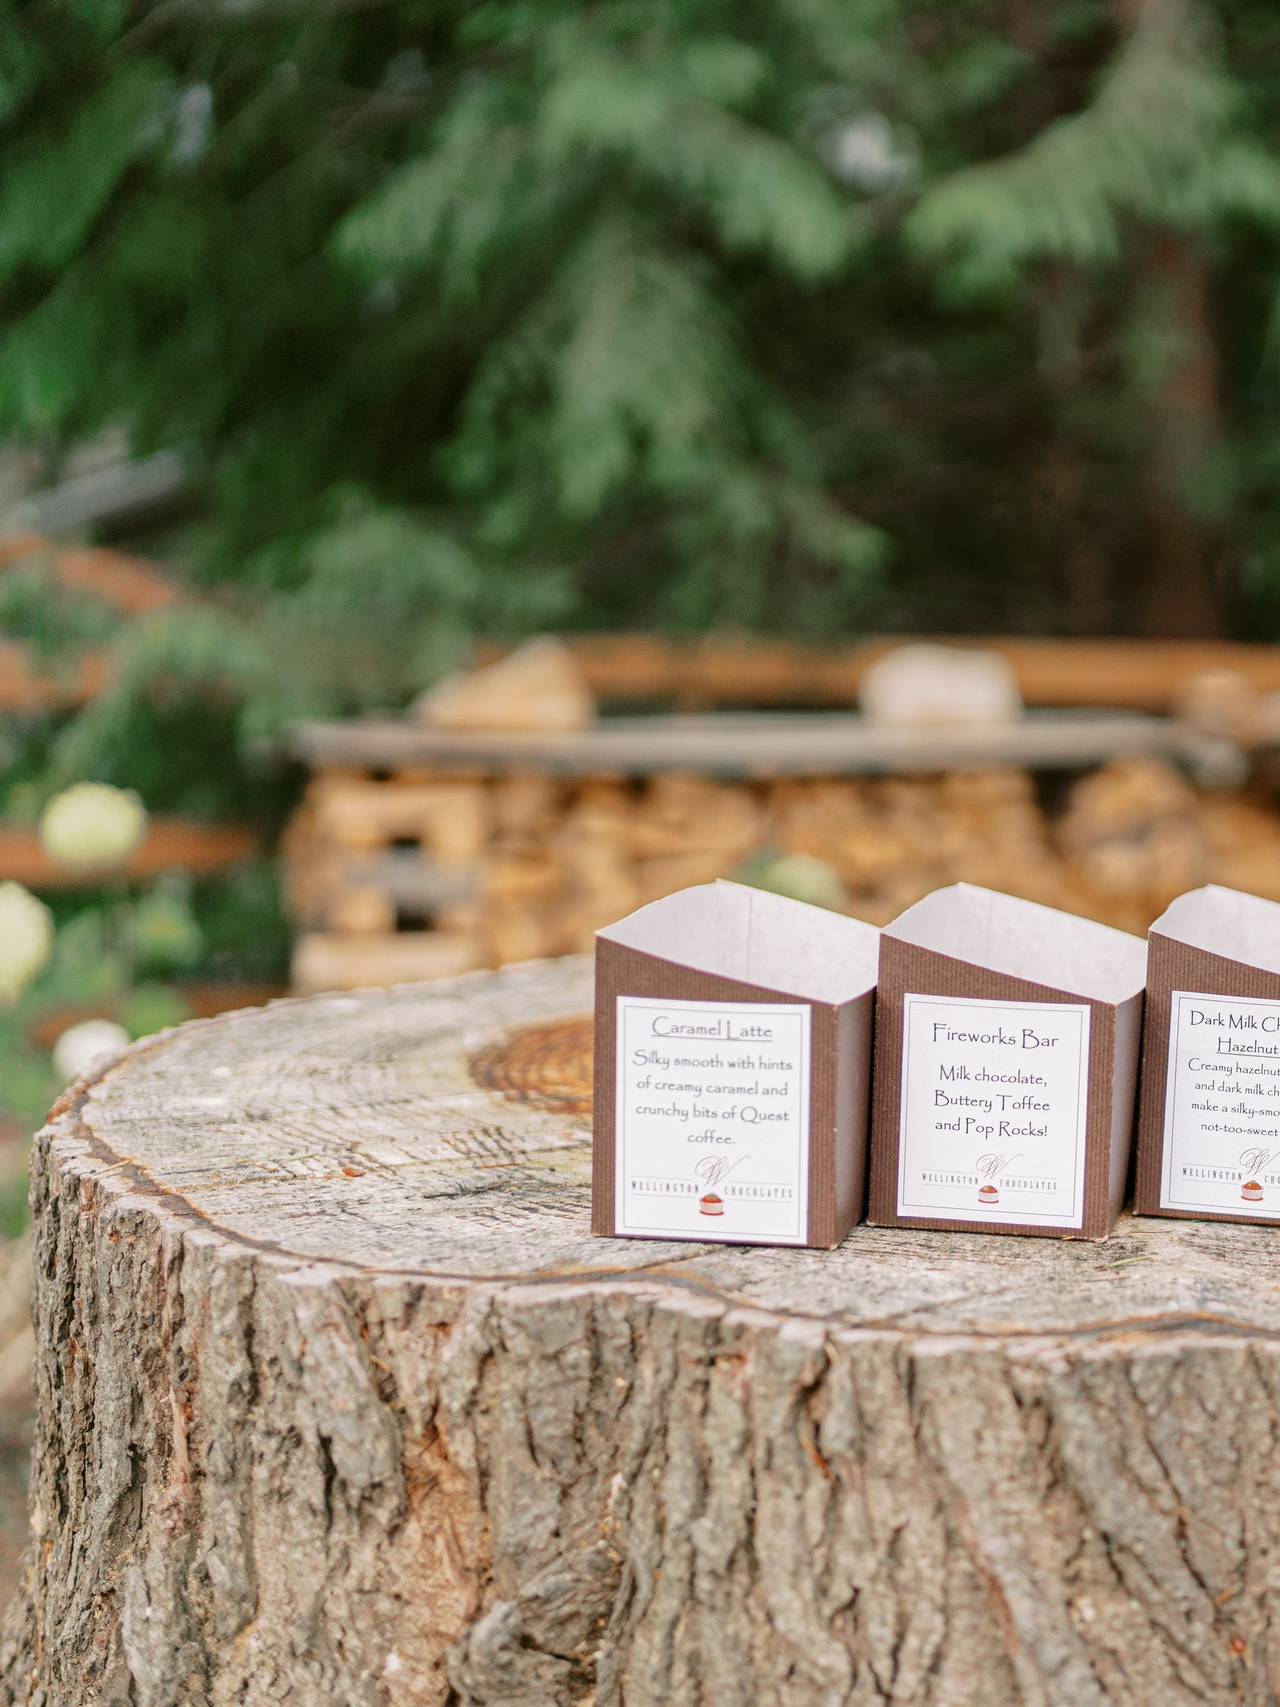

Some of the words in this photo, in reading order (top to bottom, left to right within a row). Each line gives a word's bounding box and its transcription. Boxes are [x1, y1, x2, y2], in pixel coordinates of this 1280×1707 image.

[652, 1015, 721, 1036] Caramel
[726, 1020, 773, 1039] Latte
[1190, 1010, 1225, 1026] Dark
[1229, 1014, 1258, 1029] Milk
[933, 1023, 1016, 1045] Fireworks
[1021, 1029, 1059, 1049] Bar
[1217, 1037, 1279, 1054] Hazelnut
[632, 1049, 670, 1070] Silky
[673, 1054, 723, 1068] smooth
[727, 1056, 755, 1069] with
[759, 1056, 792, 1070] hints
[1188, 1058, 1232, 1076] Creamy
[1236, 1062, 1280, 1076] hazelnut
[939, 1065, 971, 1081] Milk
[974, 1067, 1048, 1087] chocolate,
[637, 1075, 652, 1090] of
[654, 1081, 702, 1097] creamy
[706, 1081, 758, 1095] caramel
[762, 1082, 788, 1096] and
[1195, 1080, 1214, 1091] and
[1218, 1081, 1242, 1094] dark
[1245, 1084, 1264, 1096] milk
[934, 1090, 992, 1113] Buttery
[996, 1094, 1050, 1111] Toffee
[1191, 1100, 1218, 1111] make
[635, 1102, 689, 1121] crunchy
[693, 1103, 717, 1119] bits
[721, 1106, 737, 1119] of
[740, 1106, 789, 1123] Quest
[687, 1129, 735, 1145] coffee.
[935, 1117, 961, 1131] and
[965, 1118, 994, 1139] Pop
[999, 1121, 1048, 1137] Rocks!
[1201, 1122, 1279, 1137] not-too-sweet
[922, 1173, 979, 1185] WELLINGTON
[1000, 1179, 1057, 1190] CHOCOLATES
[1182, 1168, 1242, 1181] WELLINGTON
[631, 1180, 699, 1193] WELLINGTON
[724, 1186, 792, 1199] CHOCOLATES
